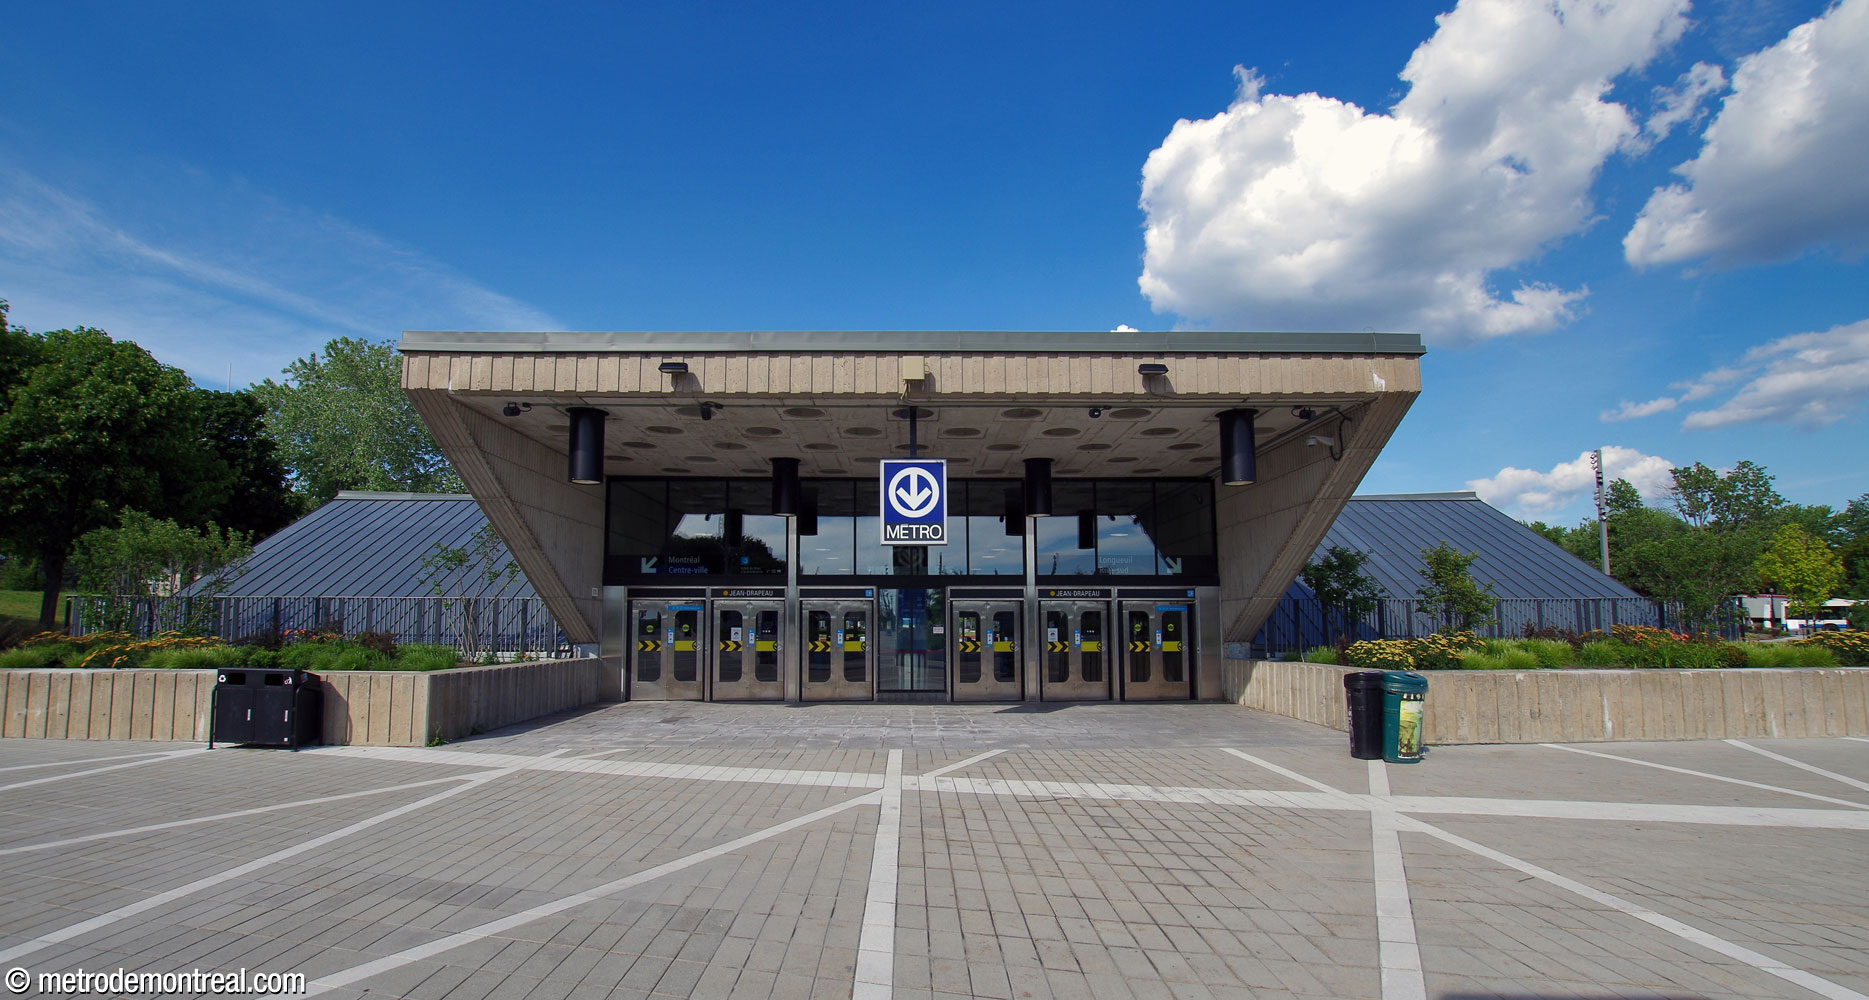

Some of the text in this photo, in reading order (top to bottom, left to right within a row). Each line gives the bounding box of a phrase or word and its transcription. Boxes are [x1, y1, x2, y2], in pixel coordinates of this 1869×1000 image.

[668, 555, 700, 563] Montréal
[1099, 555, 1133, 566] Longueuil
[668, 566, 708, 574] Centre-ville
[729, 589, 773, 597] JEAN-DRAPEAU
[1056, 590, 1100, 598] JEAN-DRAPEAU
